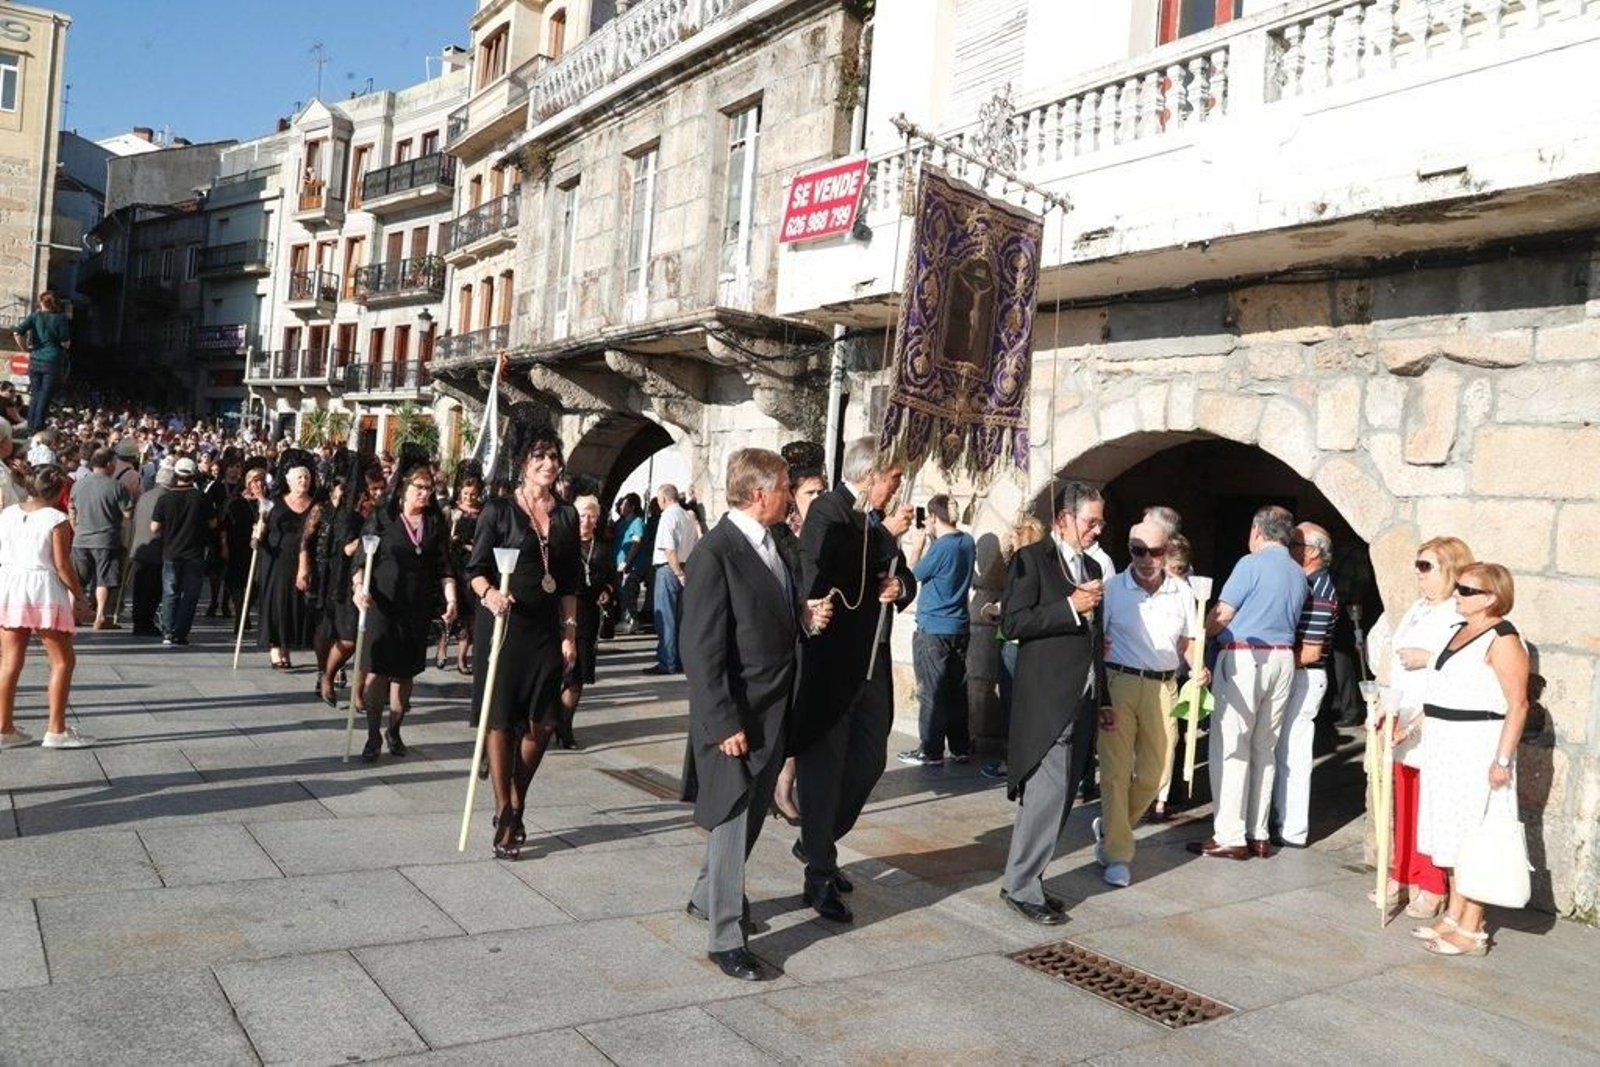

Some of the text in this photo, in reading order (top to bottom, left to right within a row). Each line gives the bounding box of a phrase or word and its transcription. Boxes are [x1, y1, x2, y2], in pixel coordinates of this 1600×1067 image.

[791, 170, 862, 208] SE VENDE
[785, 215, 807, 236] 626
[829, 204, 851, 228] 799
